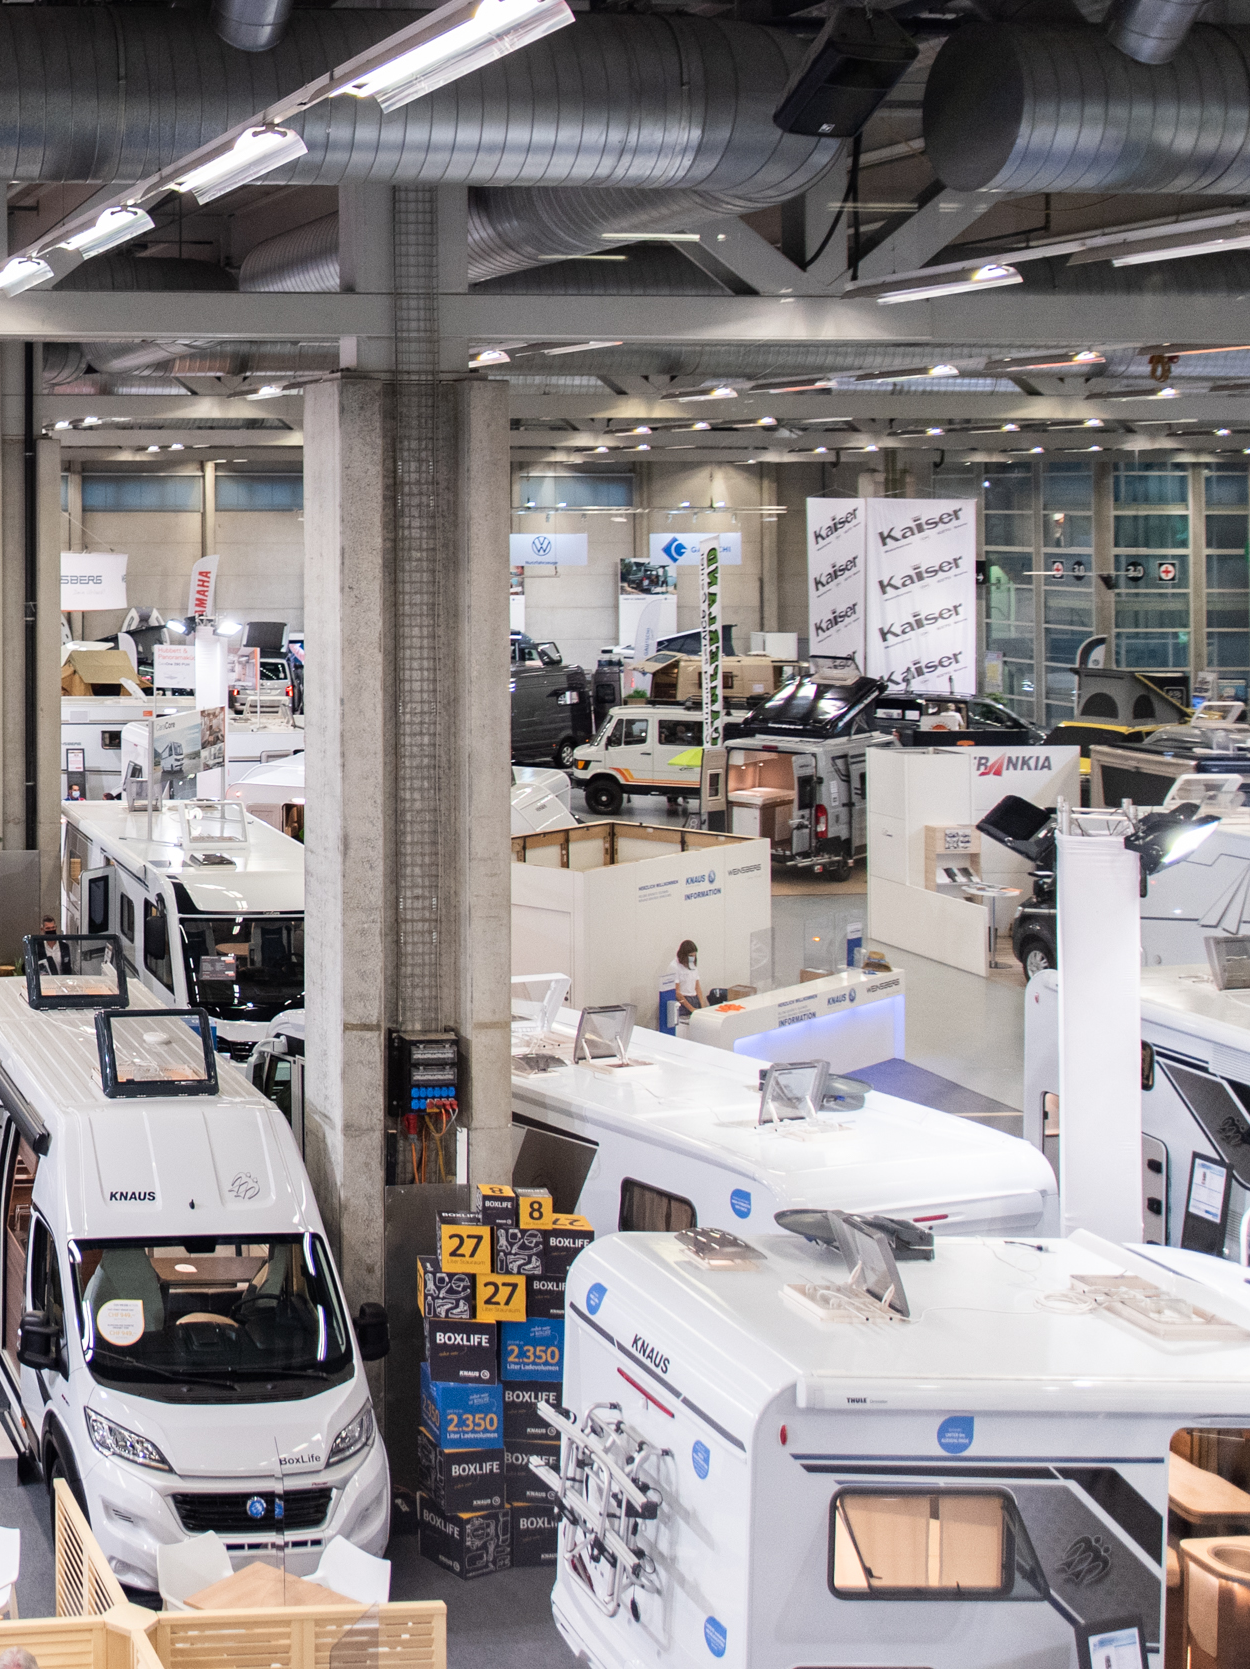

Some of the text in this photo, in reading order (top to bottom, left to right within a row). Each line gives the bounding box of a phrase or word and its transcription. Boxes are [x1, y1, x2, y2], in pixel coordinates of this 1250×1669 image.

[813, 507, 859, 546] Kaiser
[878, 507, 963, 547] Kaiser
[813, 555, 859, 592] Kaiser
[878, 555, 963, 595] Kaiser
[813, 601, 859, 637] Kaiser
[878, 602, 963, 643] Kaiser
[728, 864, 762, 876] WEINSBERG
[685, 874, 706, 886] KNAUS
[684, 888, 722, 901] INFORMATION
[866, 978, 901, 994] WEINSBERG
[827, 993, 847, 1006] KNAUS
[778, 1011, 817, 1027] INFORMATION
[109, 1191, 156, 1201] KNAUS
[485, 1200, 512, 1209] BOXLIFE
[528, 1200, 544, 1220] 8
[448, 1233, 484, 1258] 27
[550, 1237, 590, 1248] BOXLIFE
[483, 1281, 519, 1306] 27
[436, 1332, 490, 1347] BOXLIFE
[507, 1345, 560, 1364] 2.350
[631, 1333, 670, 1375] KNAUS
[505, 1390, 557, 1404] BOXLIFE
[447, 1413, 498, 1432] 2.350
[461, 1431, 498, 1439] Ladevolumen
[279, 1453, 321, 1466] BoxLife
[452, 1461, 500, 1477] BOXLIFE
[473, 1499, 491, 1507] KNAUS
[423, 1508, 460, 1540] BOXLIFE
